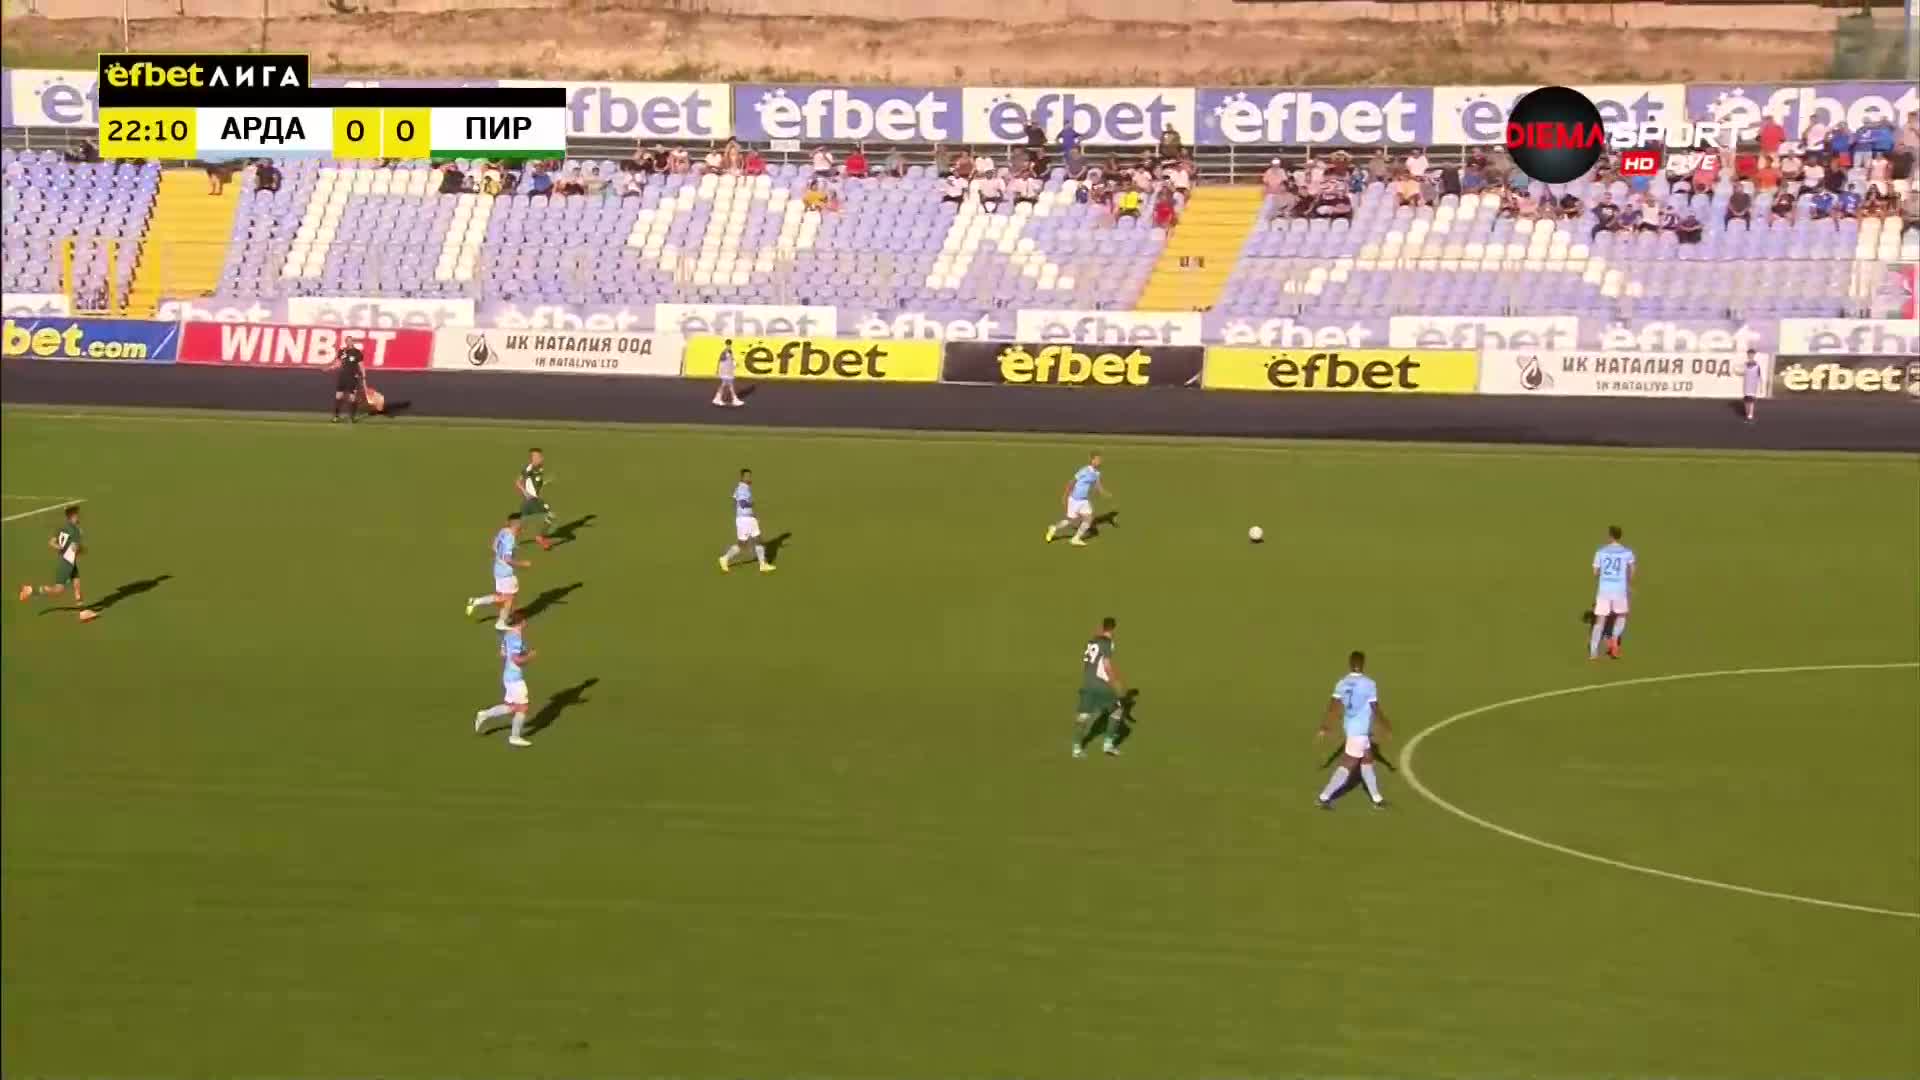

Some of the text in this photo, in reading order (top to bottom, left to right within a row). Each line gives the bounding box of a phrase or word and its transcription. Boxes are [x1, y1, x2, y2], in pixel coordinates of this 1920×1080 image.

[567, 87, 712, 135] fbet
[756, 89, 948, 141] efbet
[984, 93, 1177, 142] efbet
[1215, 92, 1417, 144] efbet
[535, 336, 610, 352] НАТАЛИЯ
[617, 338, 652, 355] ООД
[740, 341, 888, 377] efbet
[998, 345, 1151, 385] efbet
[1264, 353, 1421, 389] efbet
[1594, 357, 1684, 375] НАТАЛИЯ
[1780, 363, 1902, 391] efbet
[1603, 557, 1621, 576] 24
